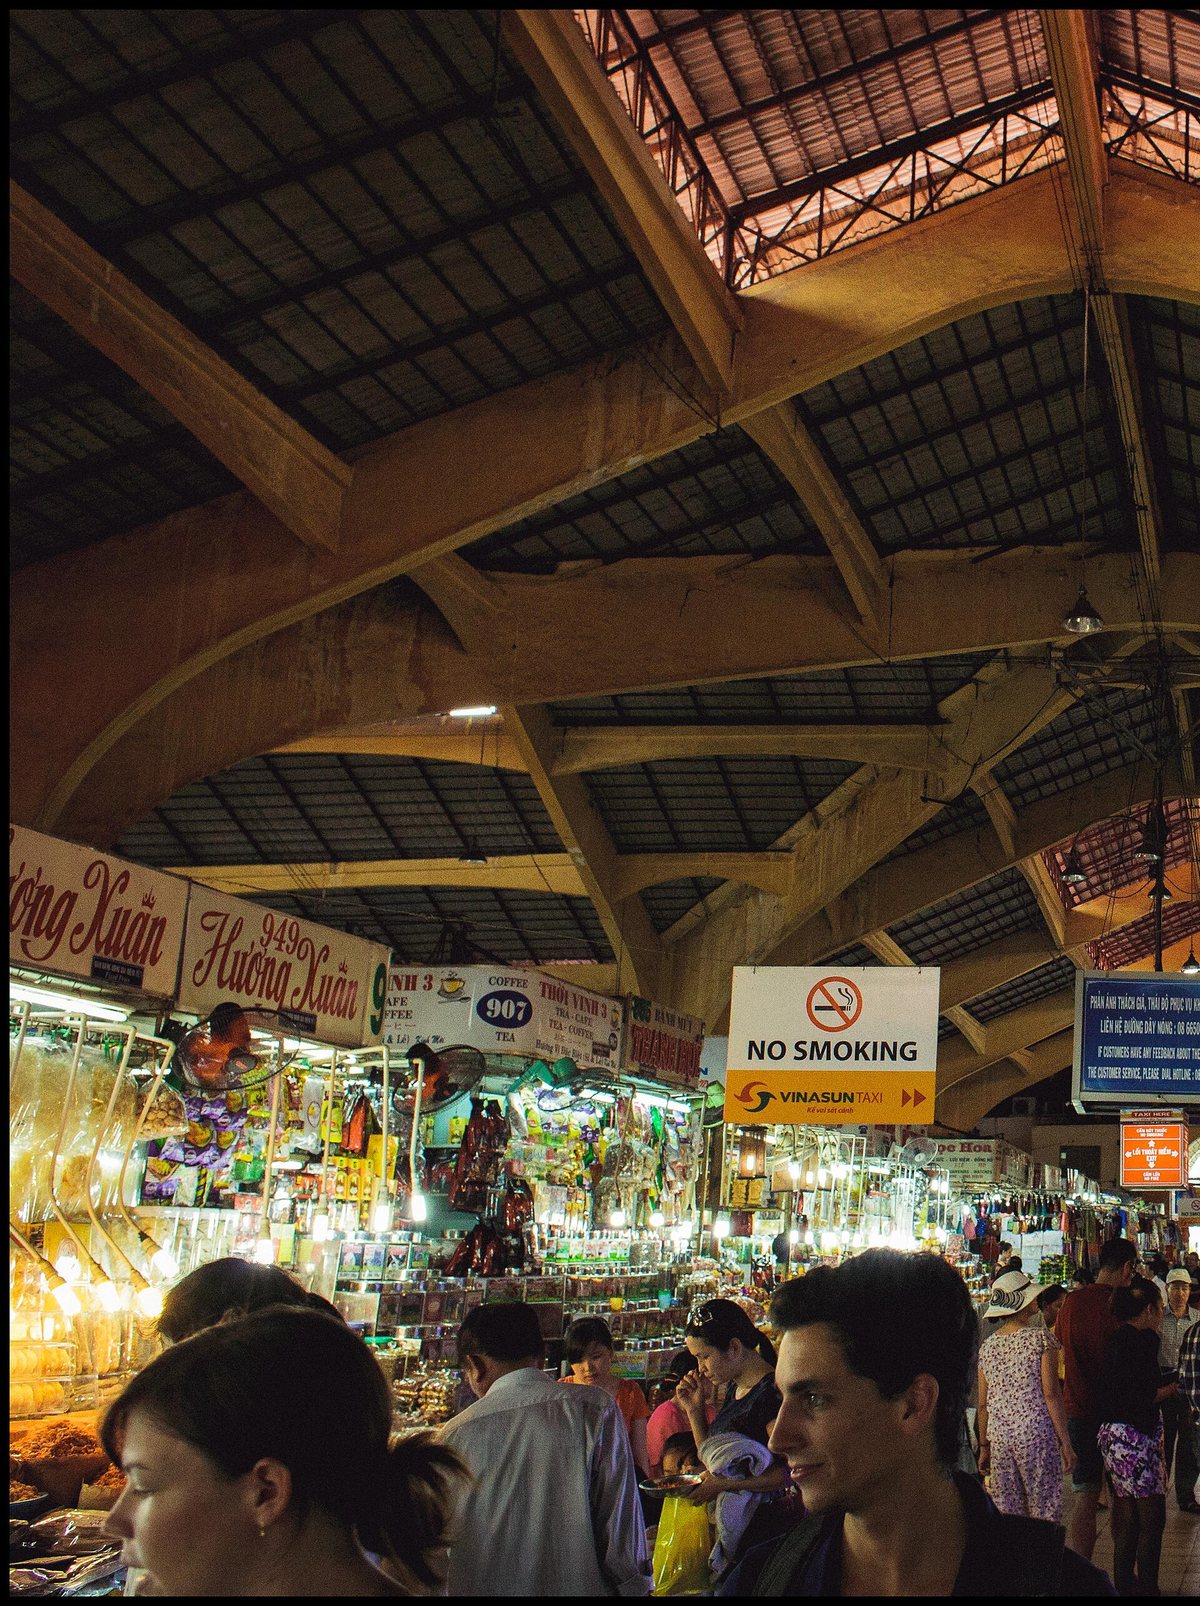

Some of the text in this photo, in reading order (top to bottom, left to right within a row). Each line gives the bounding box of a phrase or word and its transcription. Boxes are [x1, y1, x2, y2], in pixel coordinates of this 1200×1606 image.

[260, 913, 300, 955] 949
[192, 911, 293, 1012] Hương
[422, 974, 433, 991] 3
[488, 976, 529, 988] COFFEE
[386, 996, 408, 1007] AFE
[572, 993, 599, 1017] VINH
[601, 1003, 608, 1019] 3
[384, 1009, 413, 1019] FFEE
[485, 998, 528, 1021] 907
[575, 1013, 593, 1027] CAFE
[549, 1018, 564, 1032] TEA
[568, 1025, 594, 1041] COFFEE
[495, 1031, 516, 1043] TEA
[747, 1040, 918, 1061] NO SMOKING
[1098, 1046, 1103, 1058] IF
[1103, 1046, 1130, 1059] CUSTOMERS
[1130, 1046, 1142, 1059] HAVE
[1142, 1047, 1152, 1059] ANY
[1152, 1047, 1176, 1060] FEEDBACK
[1176, 1047, 1191, 1060] ABOUT
[1191, 1047, 1200, 1060] THE
[1088, 1066, 1097, 1079] THE
[1097, 1066, 1122, 1079] CUSTOMER
[1142, 1067, 1160, 1080] PLEASE
[1161, 1067, 1172, 1080] DIAL
[1172, 1068, 1192, 1081] HOTLINE
[780, 1091, 883, 1104] VINASUN TAXI
[937, 1144, 956, 1155] ọc
